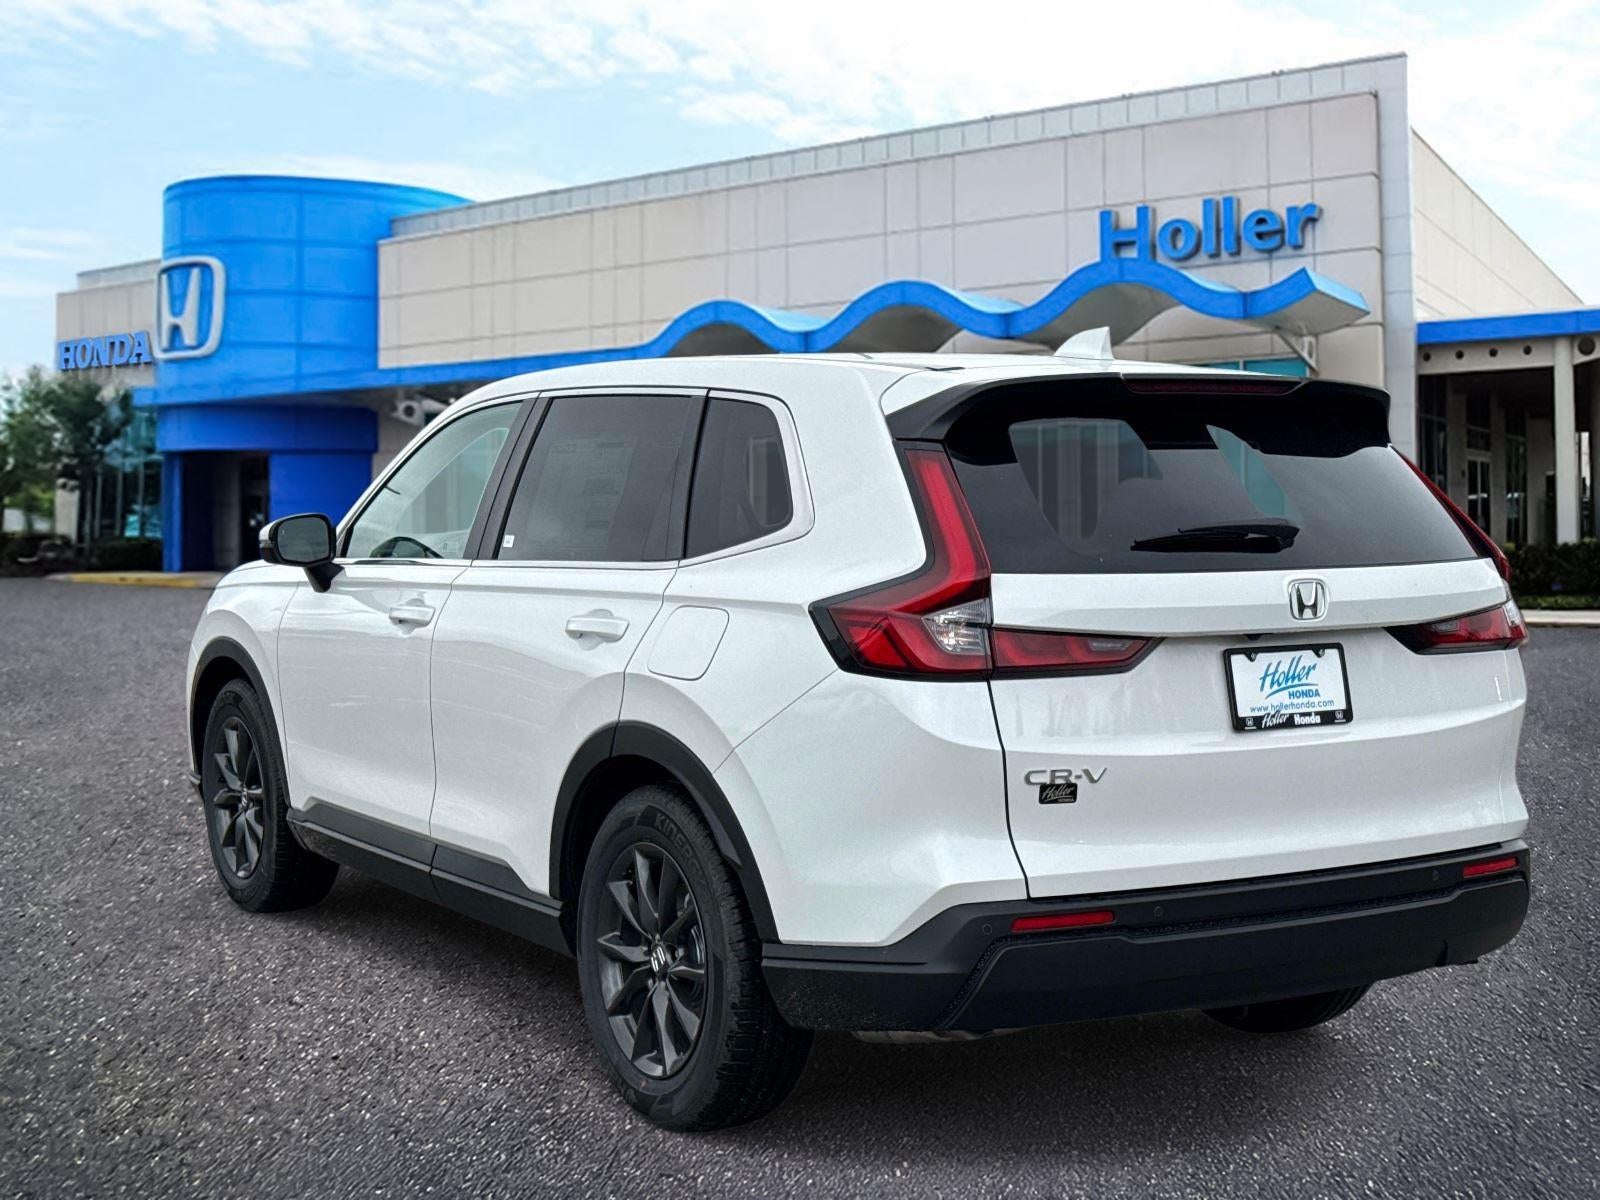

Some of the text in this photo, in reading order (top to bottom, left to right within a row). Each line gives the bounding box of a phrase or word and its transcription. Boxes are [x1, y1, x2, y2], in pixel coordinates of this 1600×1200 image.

[1099, 196, 1322, 262] Holler
[58, 331, 152, 371] HONDA
[1259, 654, 1317, 692] Holler
[1288, 688, 1320, 700] HONDA
[1261, 709, 1321, 729] Holler Honda
[1024, 767, 1108, 786] CR-V
[1041, 784, 1075, 800] Holler
